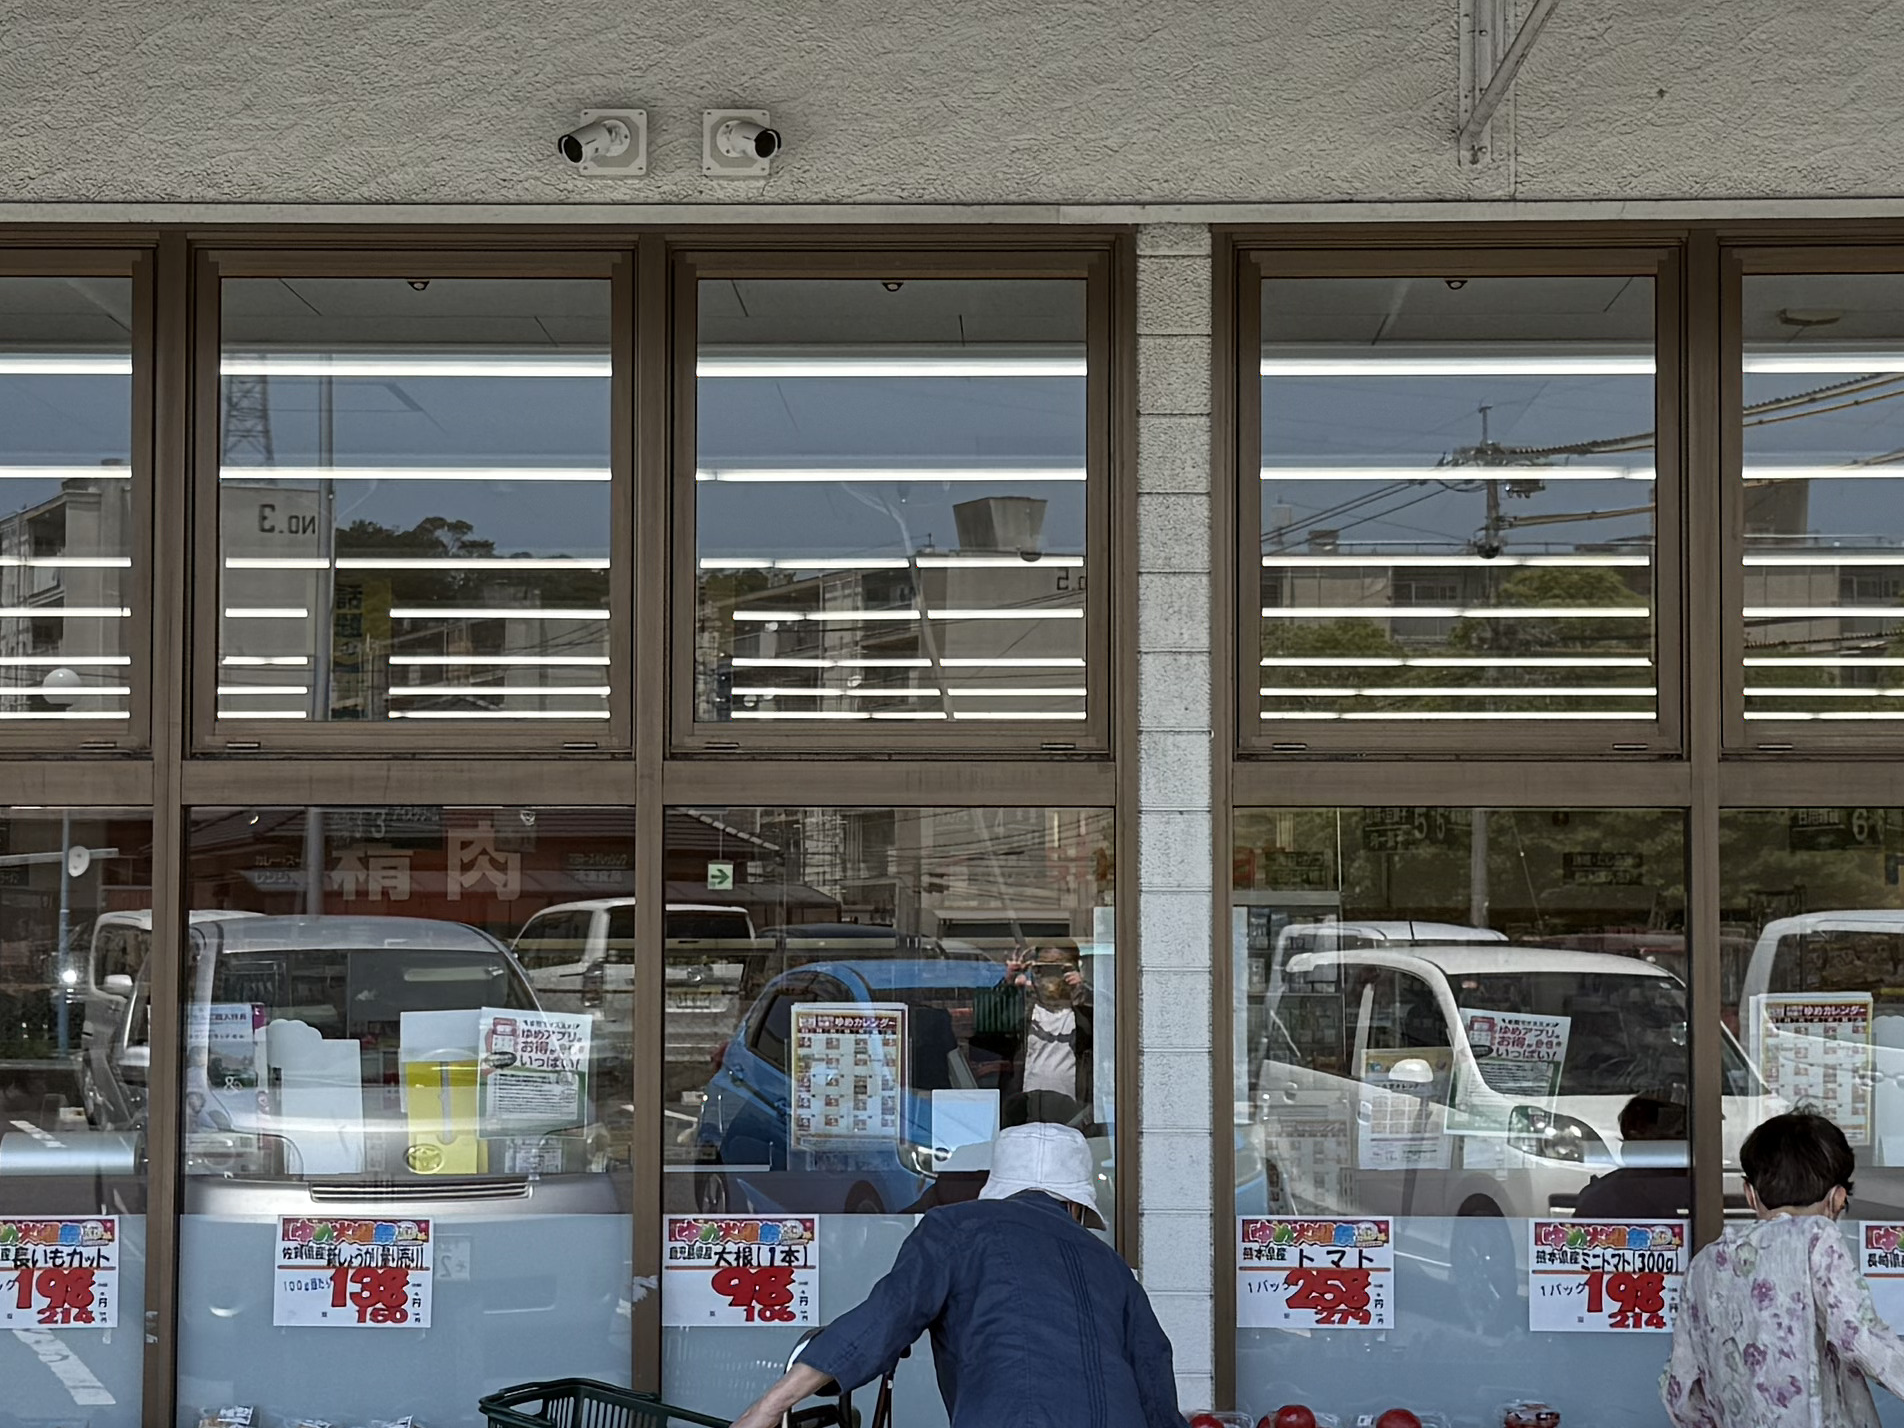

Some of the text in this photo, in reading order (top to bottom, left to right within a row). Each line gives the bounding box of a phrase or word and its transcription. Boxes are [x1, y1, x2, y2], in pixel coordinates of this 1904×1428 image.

[13, 1248, 111, 1269] 長いもカット
[1299, 1248, 1374, 1268] トマト
[15, 1268, 96, 1310] 198
[330, 1266, 410, 1308] 138
[711, 1266, 796, 1307] 98
[1284, 1268, 1372, 1310] 258
[1585, 1271, 1666, 1313] 198
[36, 1307, 96, 1324] 214
[744, 1305, 796, 1322] 106
[1607, 1312, 1667, 1329] 214
